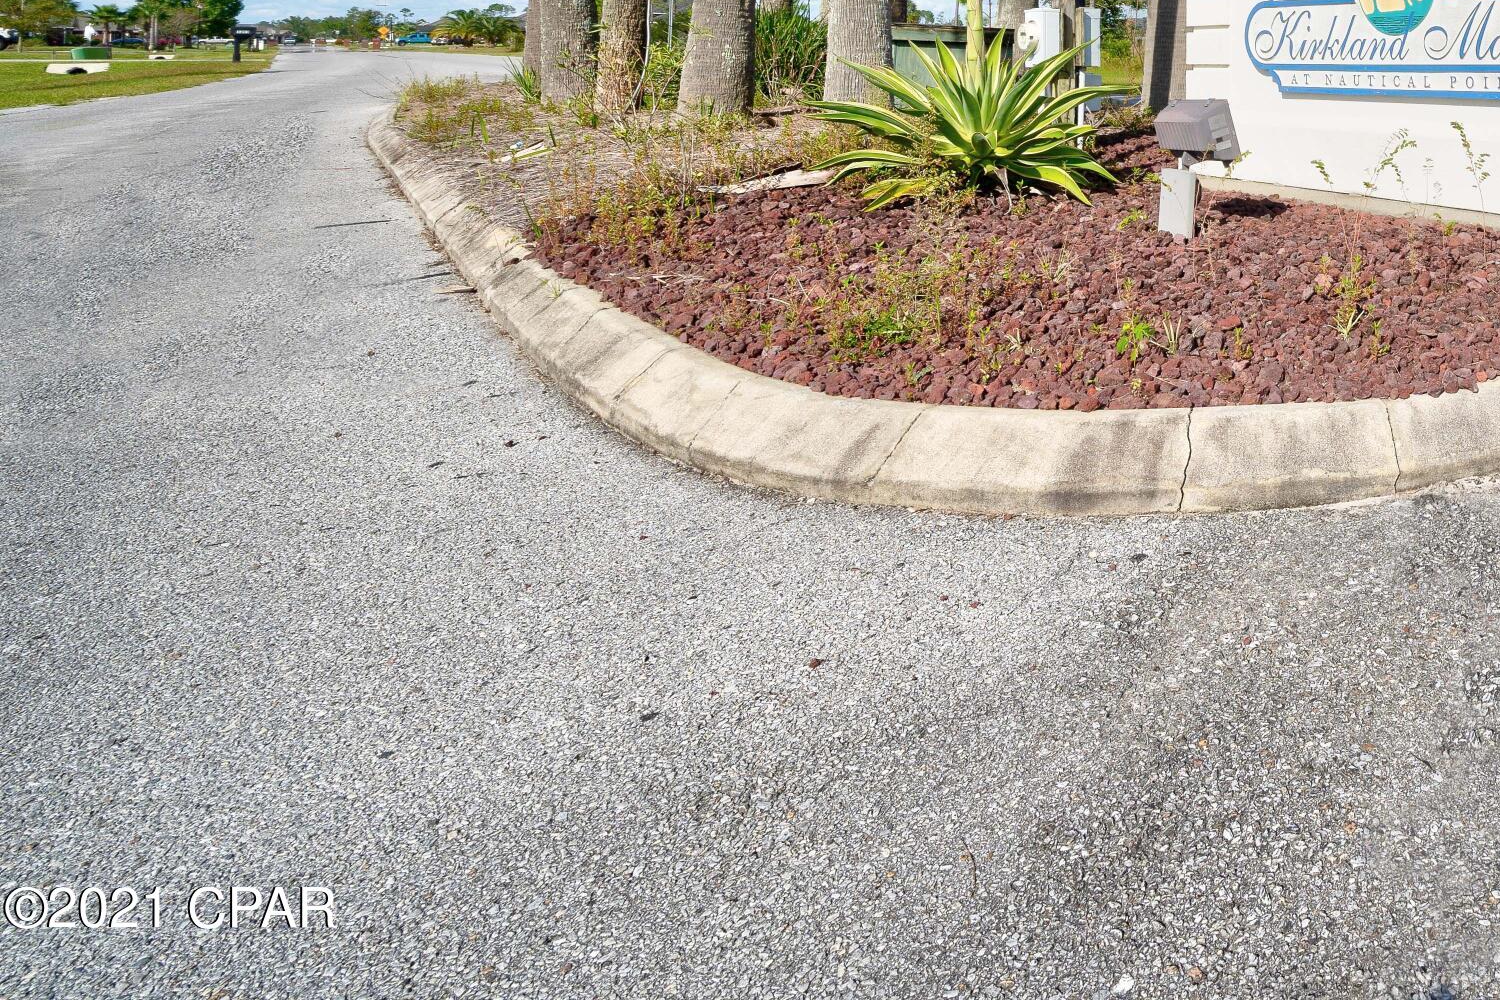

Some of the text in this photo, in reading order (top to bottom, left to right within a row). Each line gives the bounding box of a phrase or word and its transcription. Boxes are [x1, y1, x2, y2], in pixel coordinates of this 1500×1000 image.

[1254, 10, 1413, 62] Kirkland
[1290, 73, 1312, 85] AT
[1325, 73, 1431, 89] NAUTICAL
